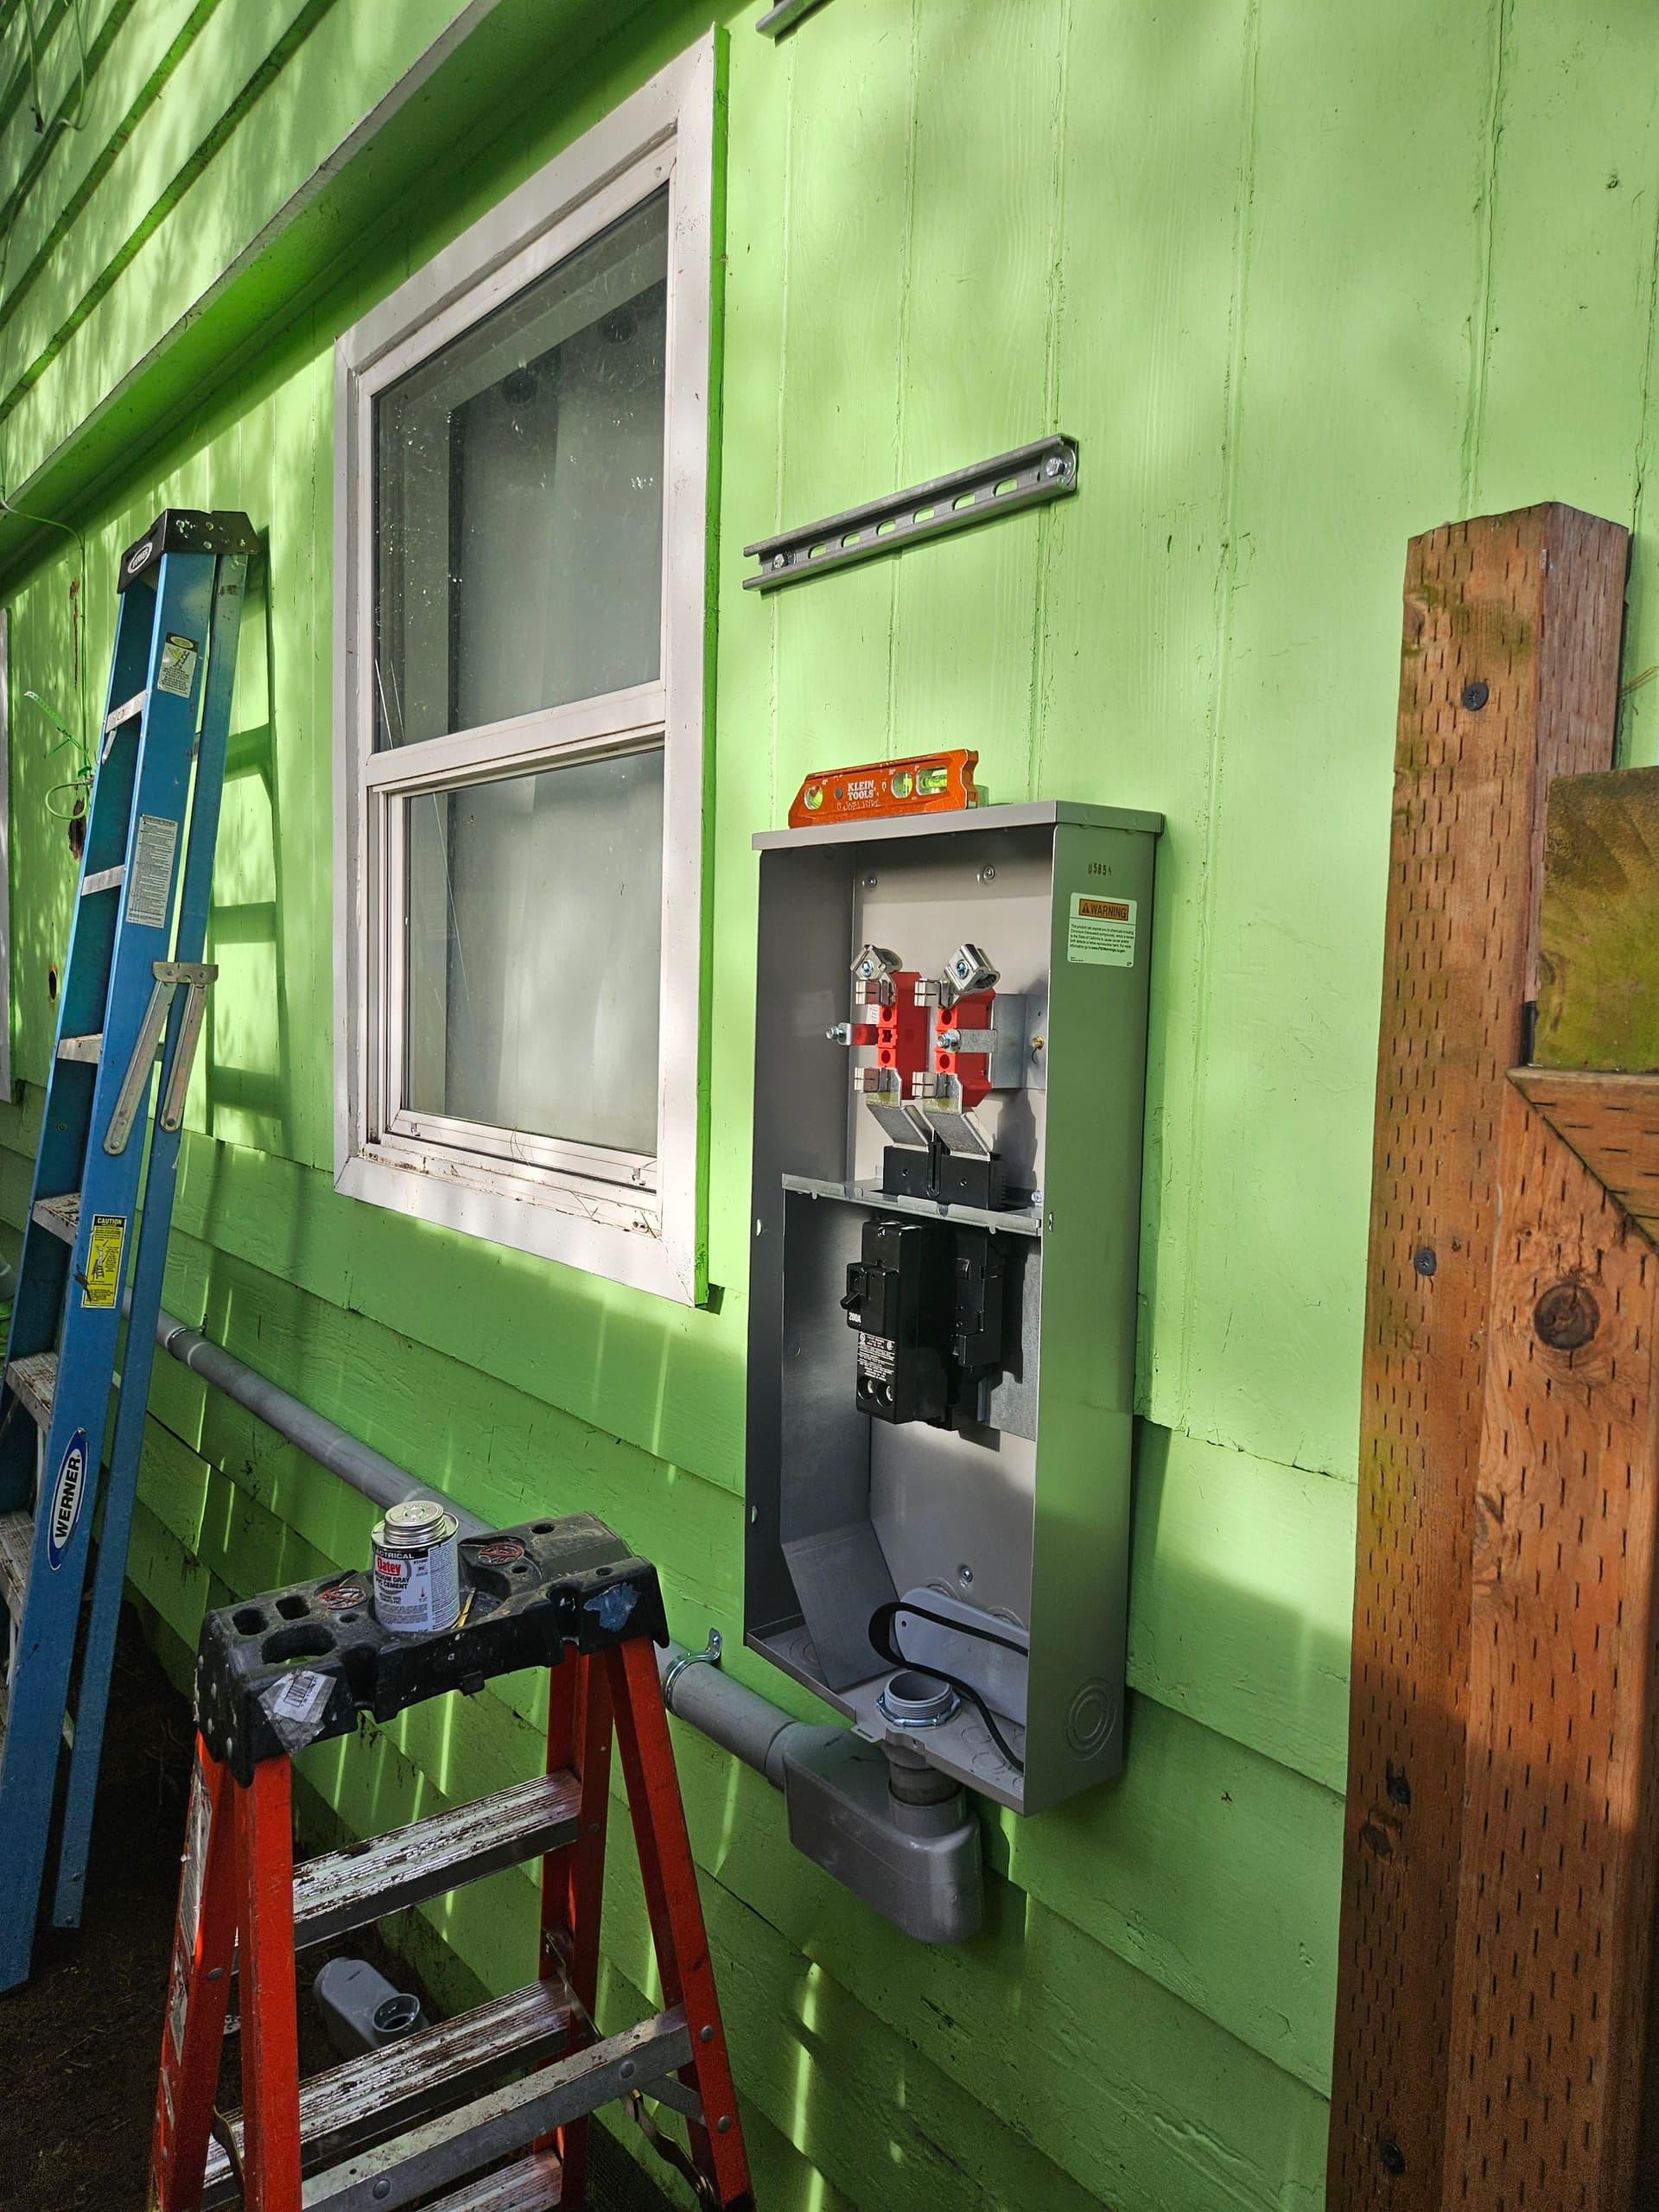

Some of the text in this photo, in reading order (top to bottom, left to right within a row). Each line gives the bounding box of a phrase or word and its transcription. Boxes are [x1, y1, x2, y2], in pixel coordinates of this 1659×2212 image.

[848, 779, 874, 792] KLEIN
[848, 789, 874, 801] TOOLS
[1090, 903, 1127, 918] WARNING
[97, 1217, 123, 1225] CAUTION
[54, 1456, 82, 1538] WERNER
[377, 1556, 402, 1576] Oatey
[383, 1580, 408, 1590] CEMENT
